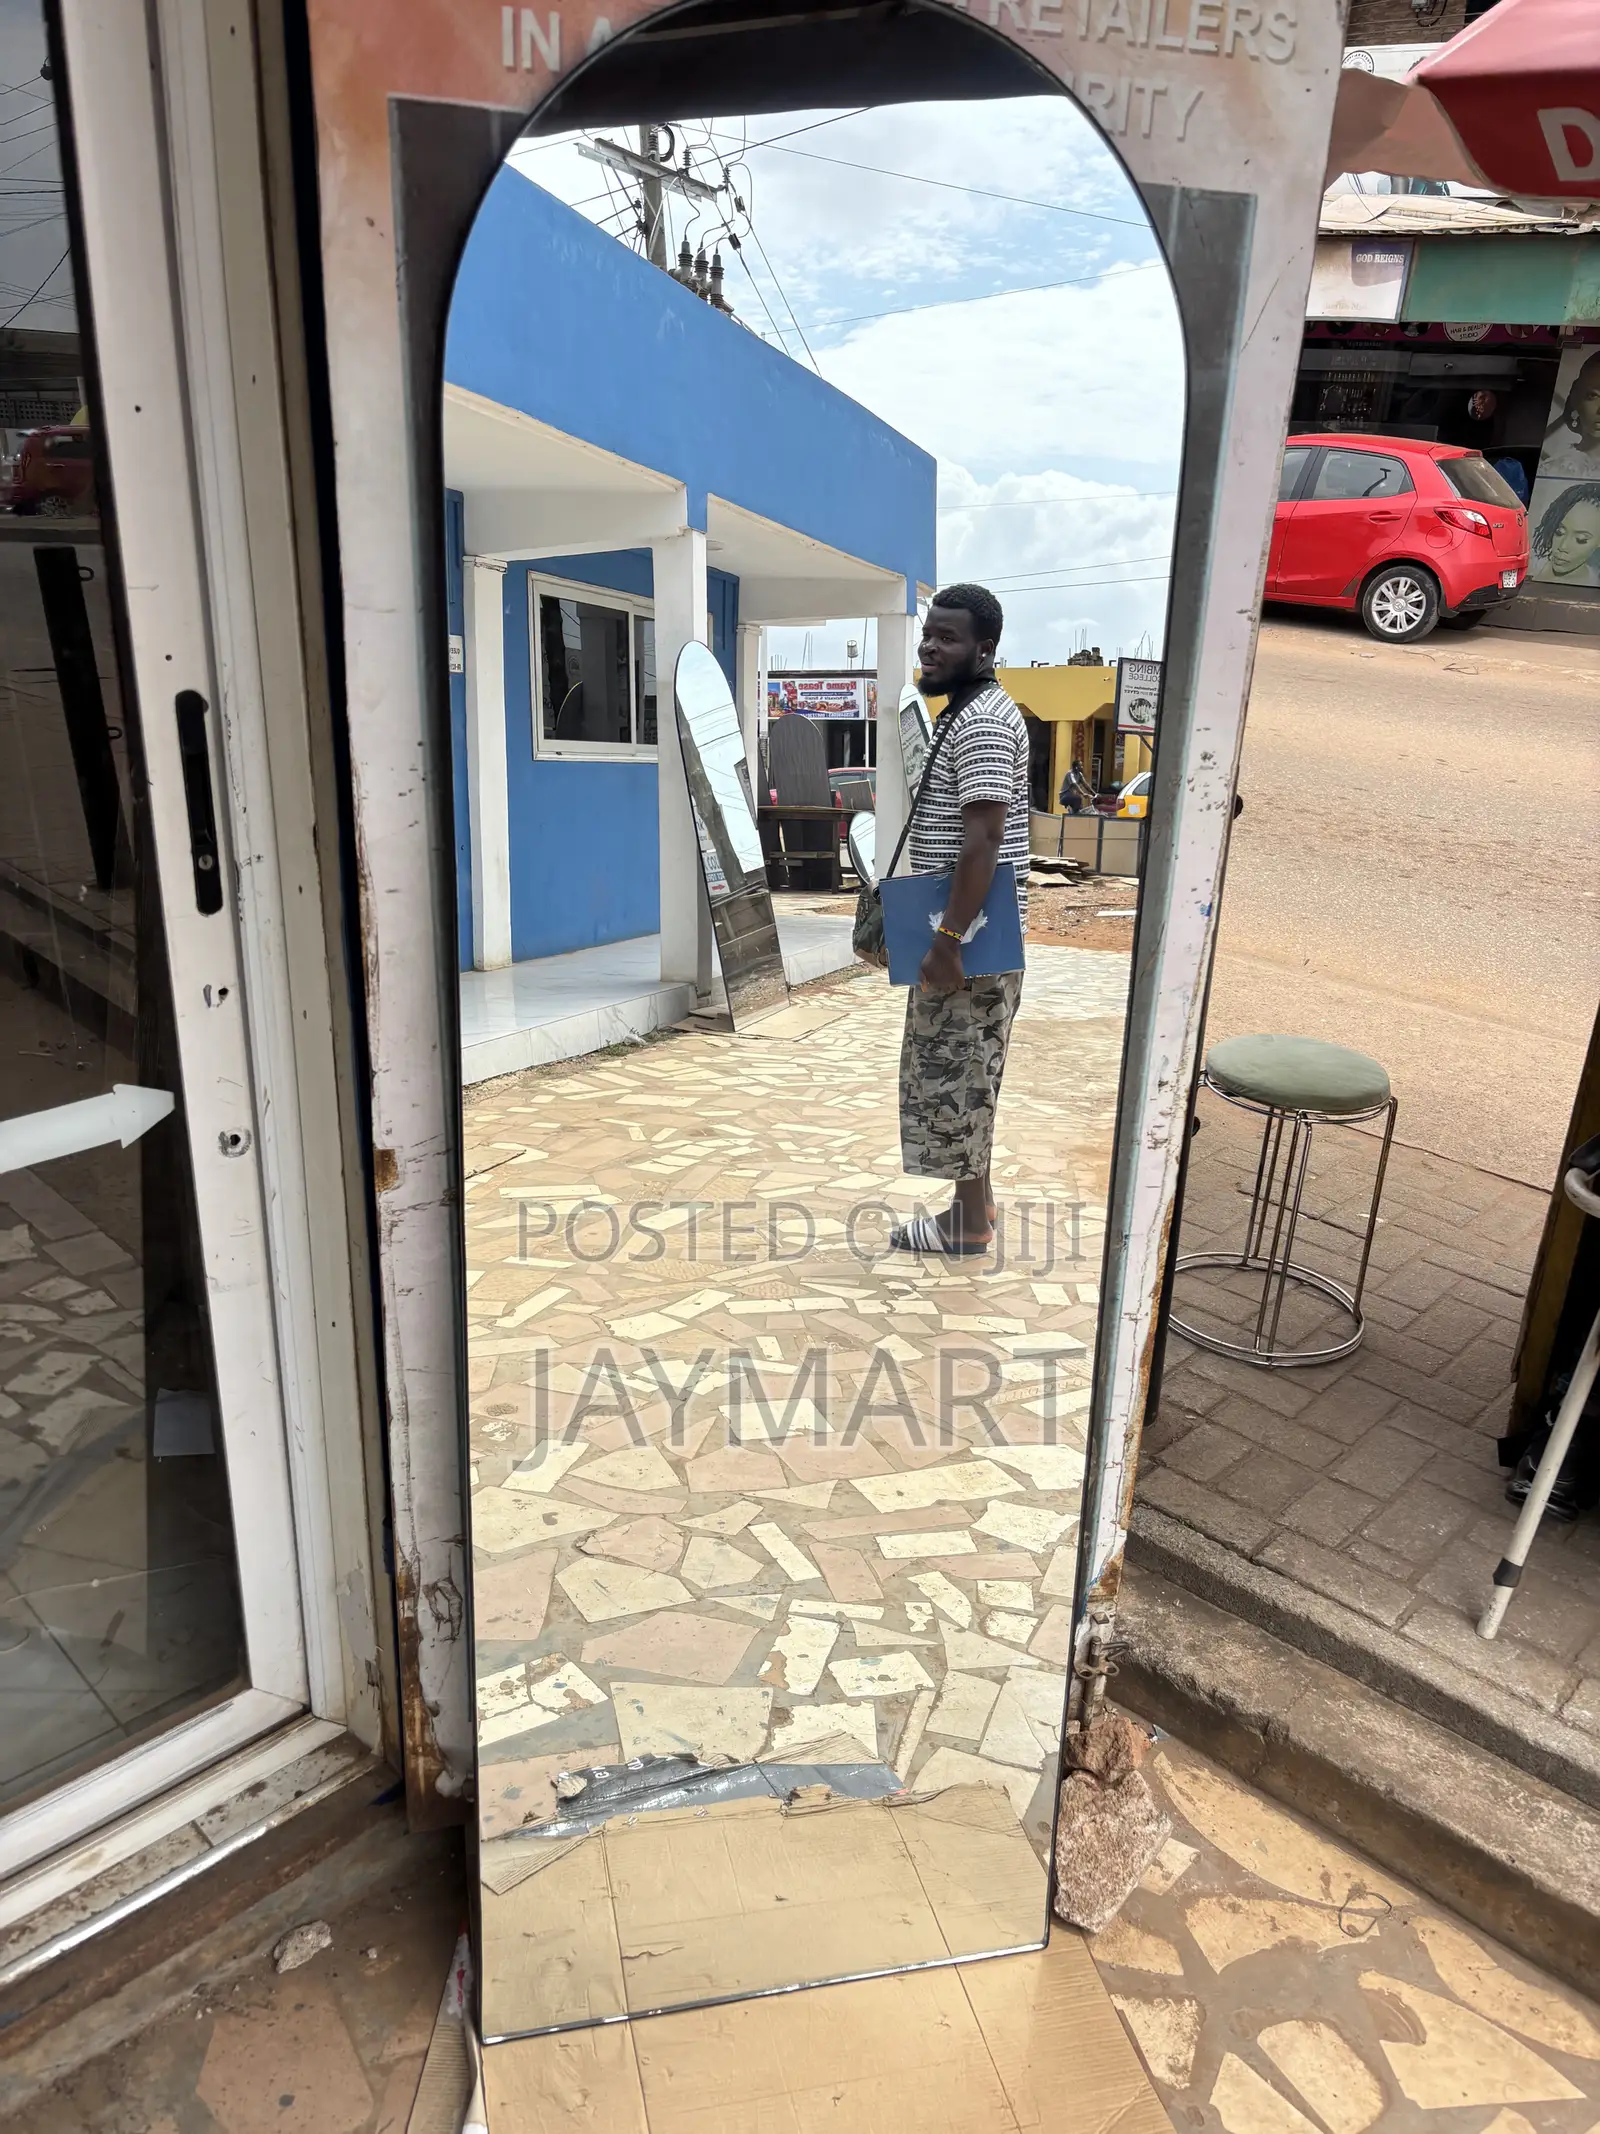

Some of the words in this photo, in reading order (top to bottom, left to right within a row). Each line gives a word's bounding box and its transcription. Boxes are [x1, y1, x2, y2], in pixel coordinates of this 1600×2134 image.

[501, 5, 561, 73] IN
[1064, 70, 1204, 143] RITY
[1355, 253, 1374, 263] GOD
[1374, 253, 1405, 264] REIGNS
